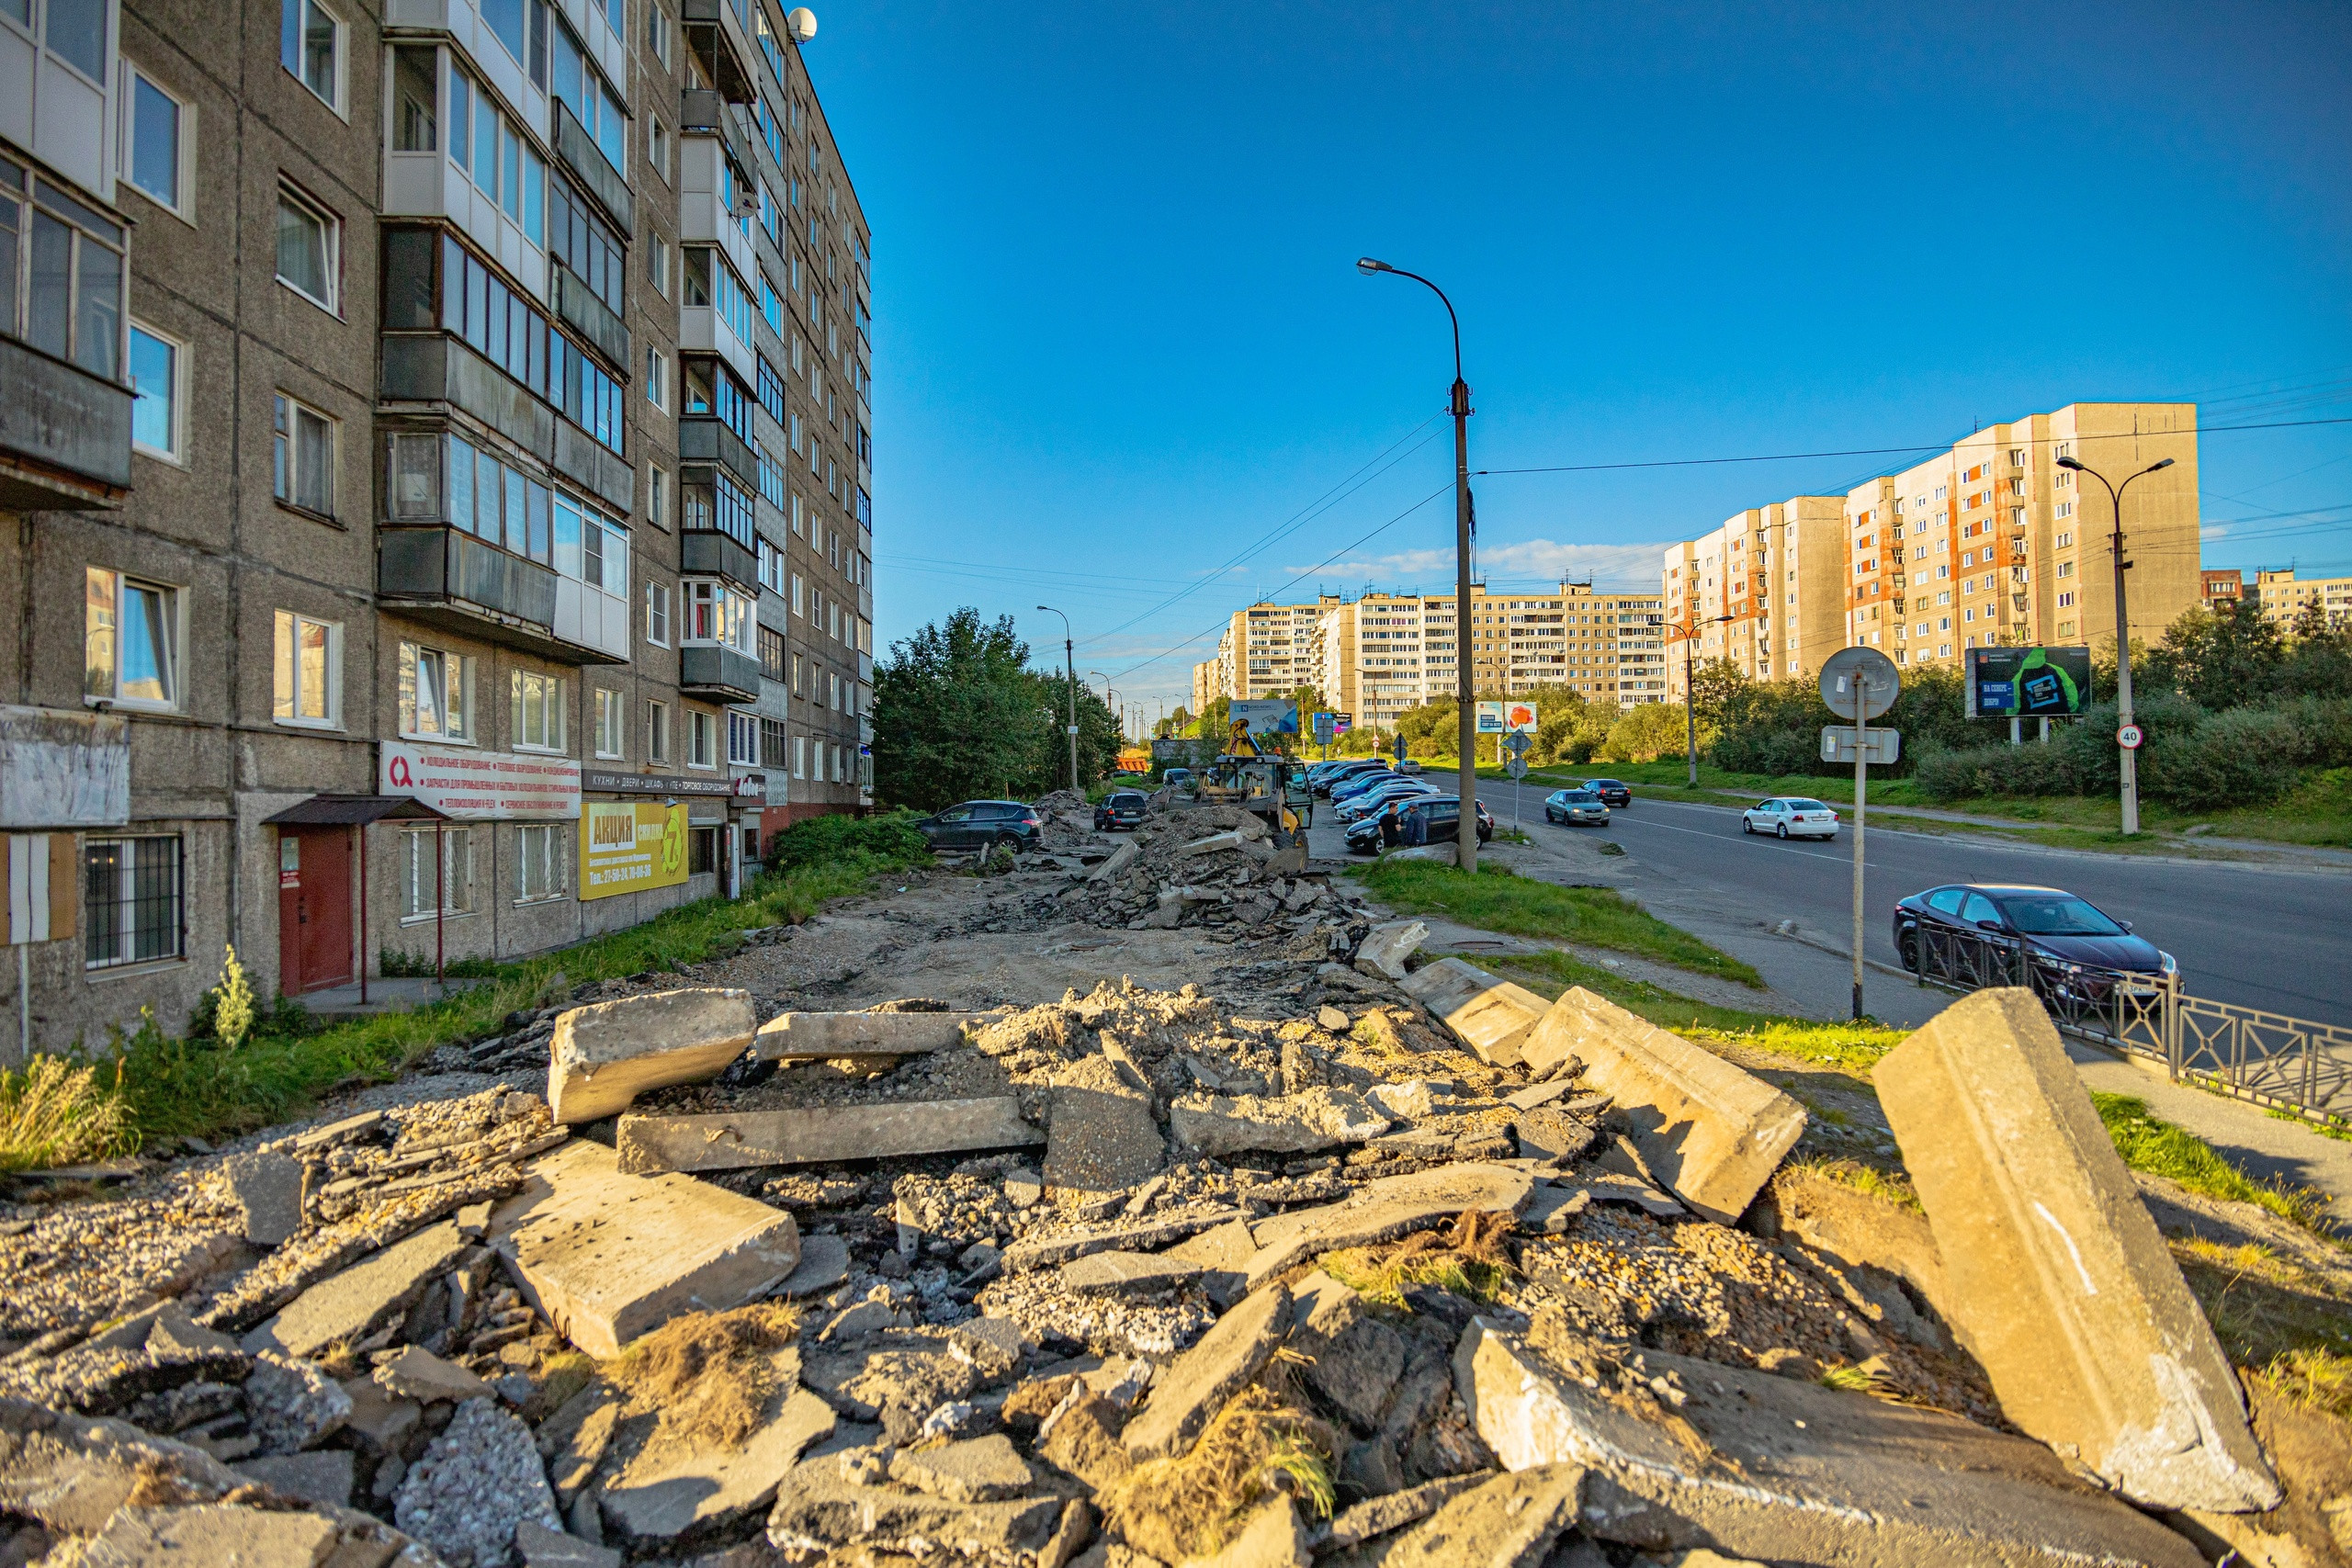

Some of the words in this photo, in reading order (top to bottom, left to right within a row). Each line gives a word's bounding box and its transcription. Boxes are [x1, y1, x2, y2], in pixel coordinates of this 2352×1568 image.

[2123, 732, 2137, 741] 40
[592, 774, 616, 787] КУХНИ
[621, 777, 640, 788] ДВЕРИ
[682, 781, 702, 791] ТОРГОВОЕ
[702, 782, 730, 793] ОБОРУДОВАНИЕ
[594, 815, 633, 848] АКЦИЯ
